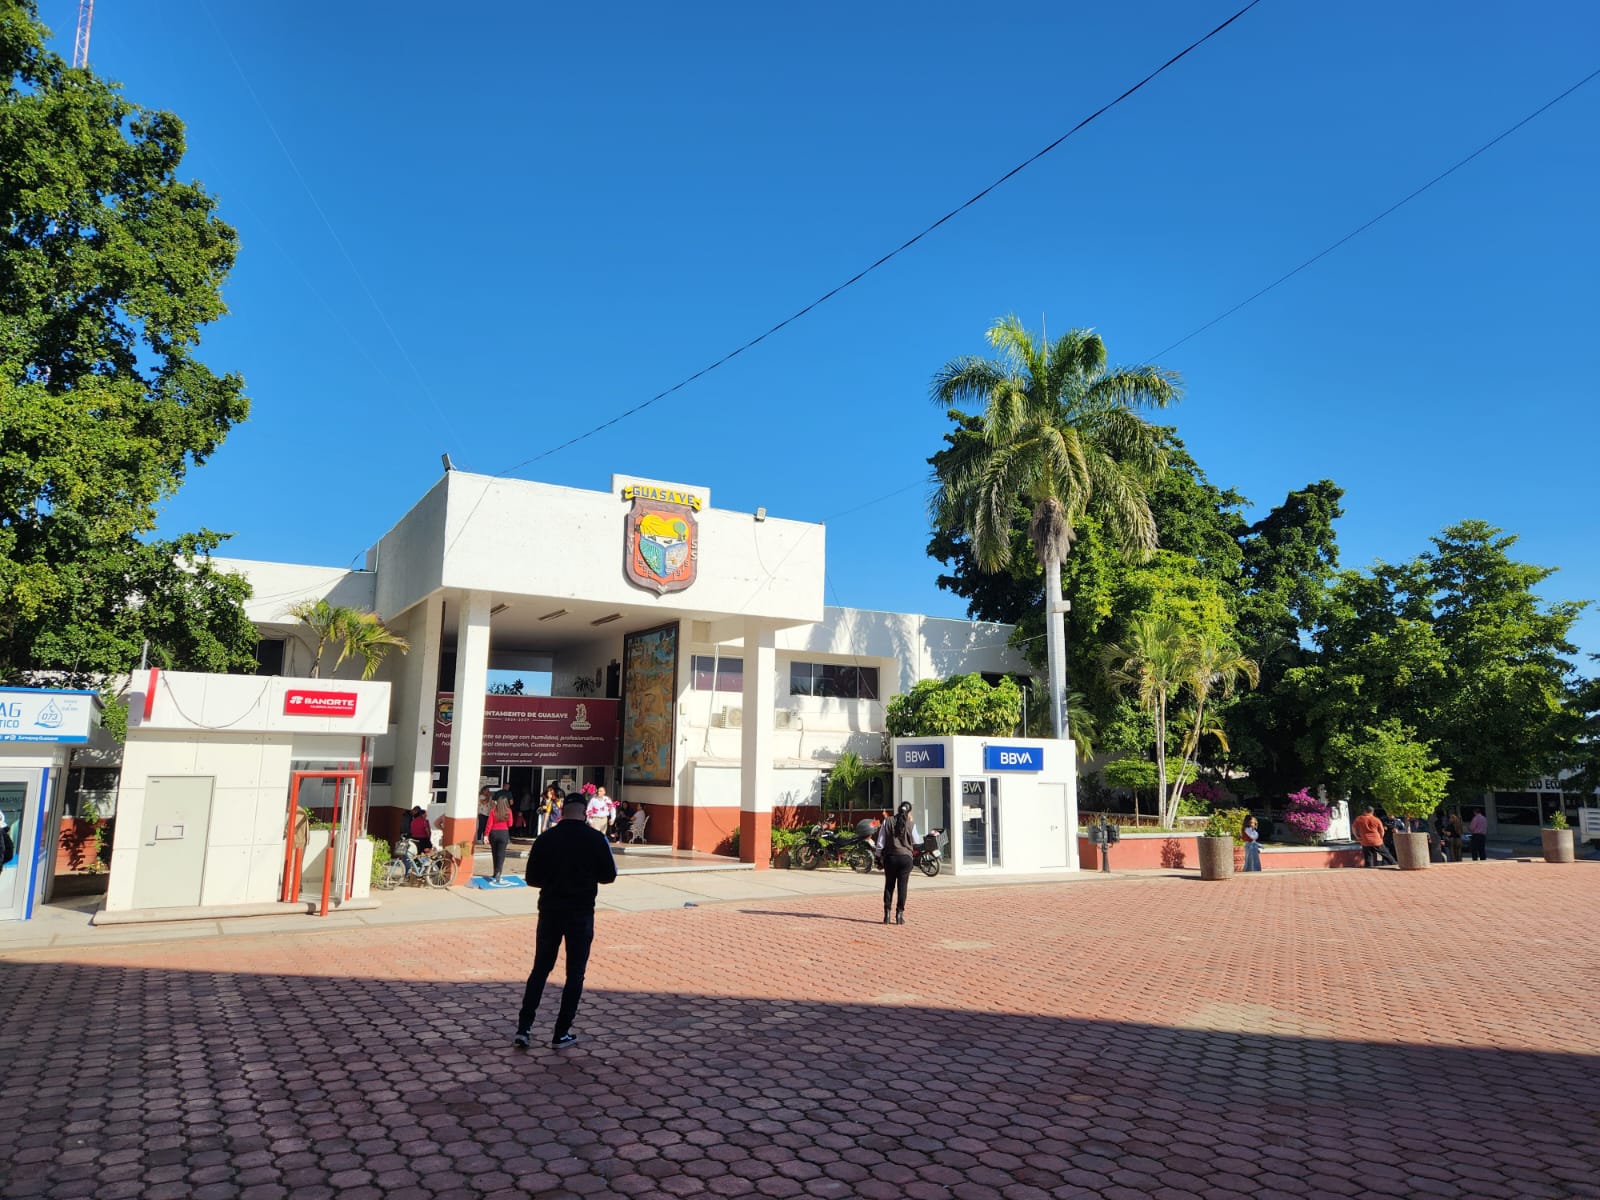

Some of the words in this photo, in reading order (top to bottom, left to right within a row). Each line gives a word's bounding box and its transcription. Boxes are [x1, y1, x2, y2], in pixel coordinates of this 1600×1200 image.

[633, 486, 695, 504] GUASAVE
[304, 697, 354, 706] BANORTE
[905, 750, 930, 762] BBVA
[1000, 752, 1033, 764] BBVA
[962, 782, 982, 793] BVA
